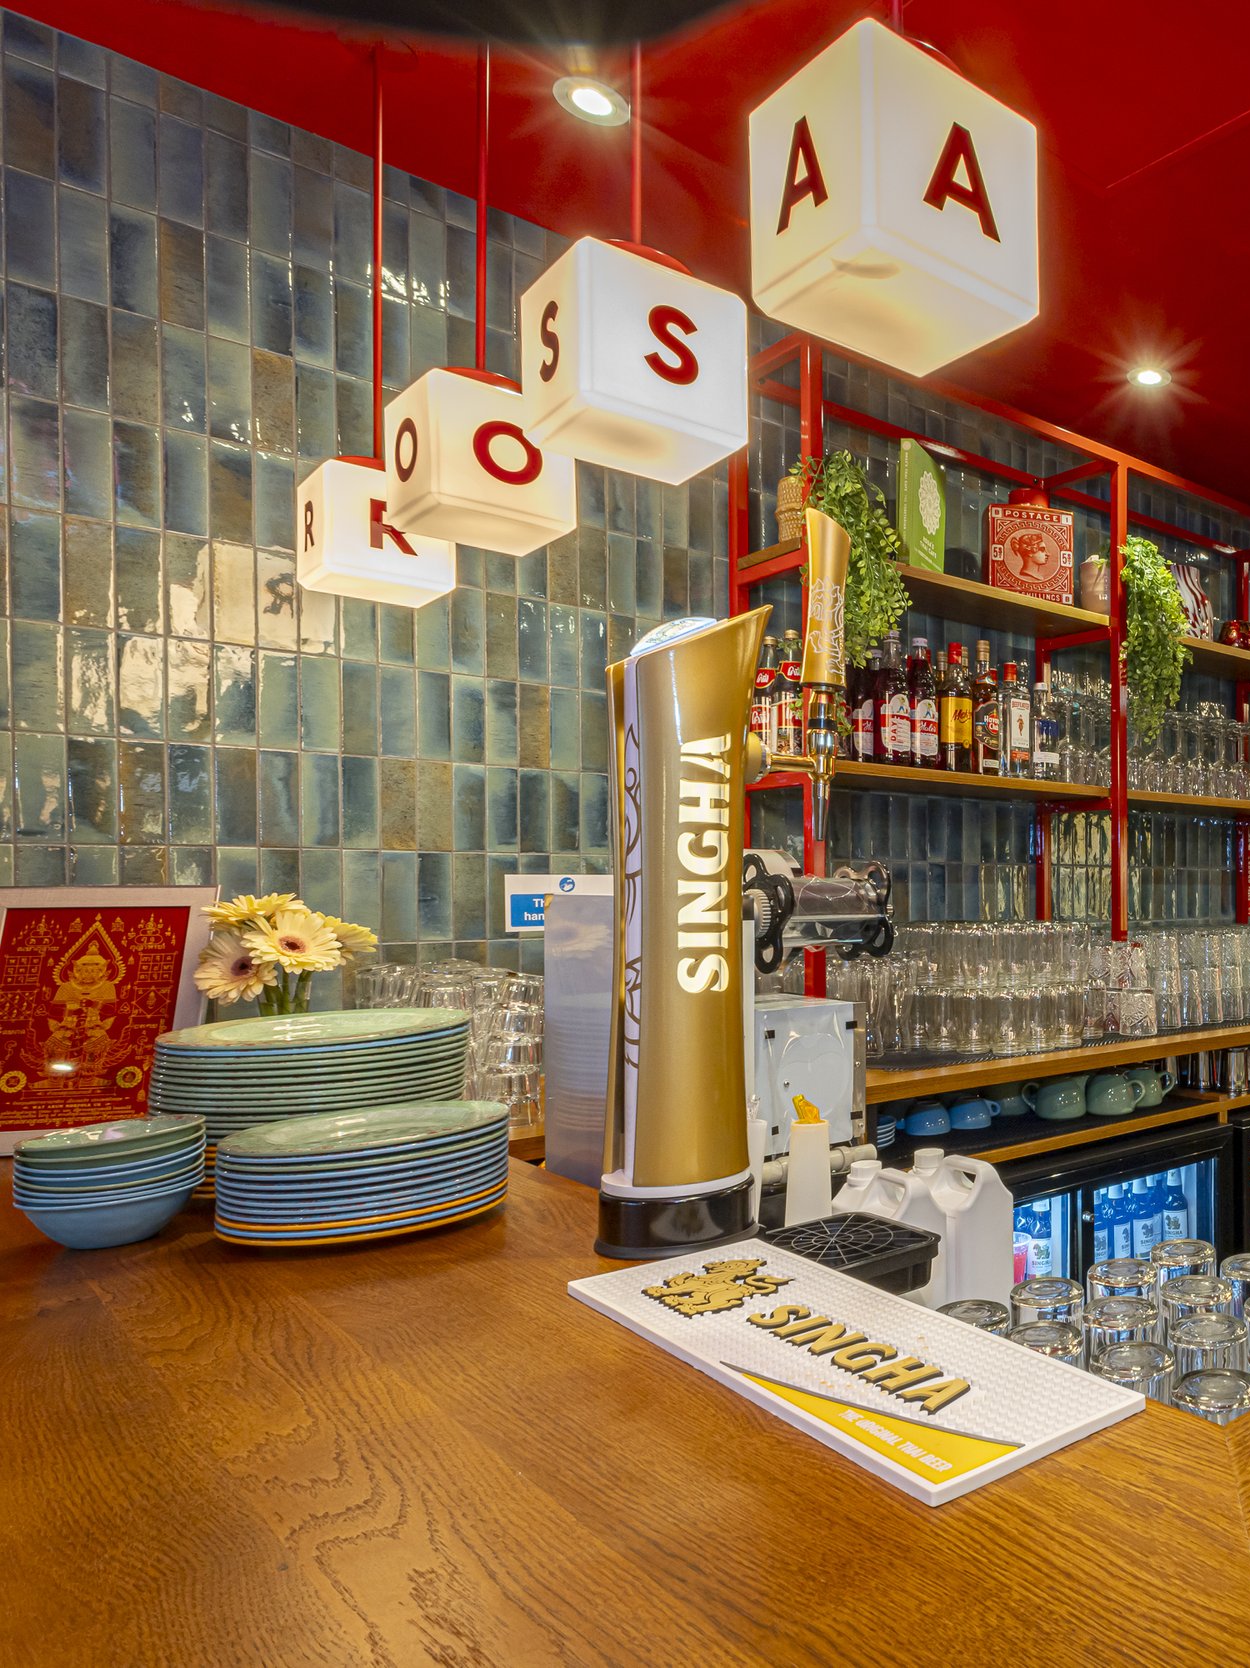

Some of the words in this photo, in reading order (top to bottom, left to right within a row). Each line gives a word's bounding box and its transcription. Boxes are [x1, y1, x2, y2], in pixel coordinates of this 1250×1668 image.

[776, 115, 828, 236] A
[922, 121, 1001, 243] A
[540, 300, 559, 382] S
[643, 305, 698, 385] S
[394, 417, 417, 482] O
[472, 420, 542, 485] O
[303, 500, 315, 552] R
[369, 498, 418, 557] R
[1005, 510, 1059, 522] POSTAGE
[889, 721, 898, 742] DAY
[676, 732, 733, 995] SINGHA
[747, 1303, 971, 1415] SINGHA
[896, 1441, 927, 1458] THAI
[919, 1454, 953, 1472] BEER
